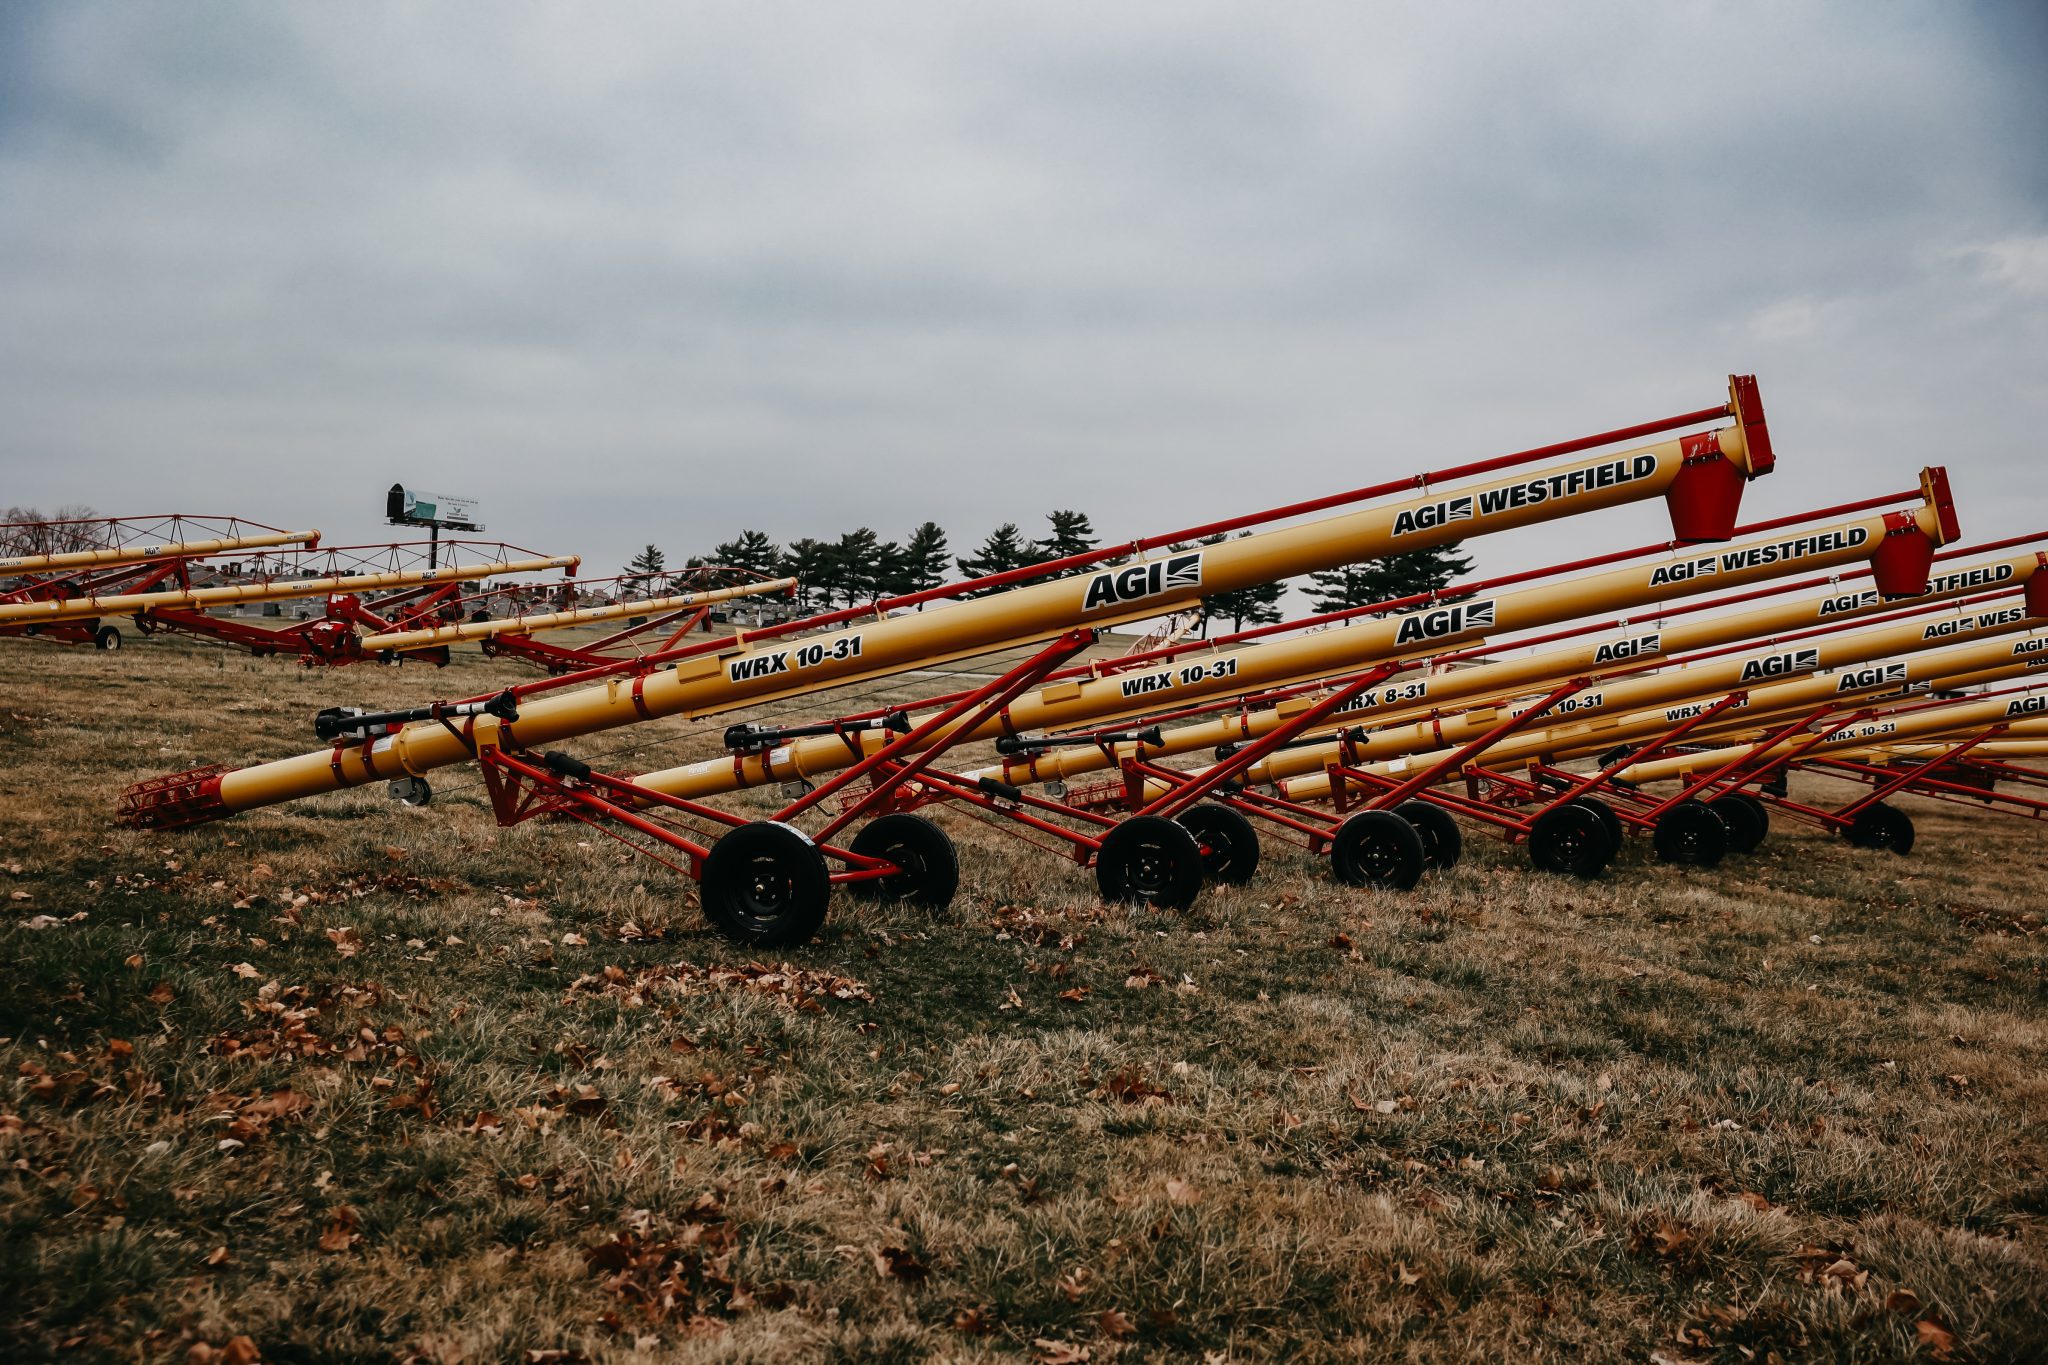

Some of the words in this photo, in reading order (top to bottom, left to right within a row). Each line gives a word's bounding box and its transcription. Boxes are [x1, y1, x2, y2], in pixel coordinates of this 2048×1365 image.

[1392, 502, 1446, 536] AGI
[1478, 454, 1657, 515] WESTFIELD
[1650, 560, 1695, 586] AGI
[1721, 527, 1868, 571] WESTFIELD
[1084, 562, 1163, 609] AGI
[1819, 593, 1859, 615] AGI
[1396, 606, 1462, 645] AGI
[1923, 618, 1958, 639] AGI
[730, 650, 789, 682] WRX
[795, 634, 863, 668] 10-31
[1595, 638, 1639, 663] AGI
[2013, 638, 2043, 655] AGI
[1121, 671, 1173, 698] WRX
[1179, 658, 1237, 685] 10-31
[1741, 653, 1793, 681] AGI
[1836, 667, 1884, 692] AGI
[1384, 682, 1427, 704] 8-31
[1558, 693, 1603, 714] 10-31
[2006, 695, 2046, 716] AGI
[1666, 704, 1702, 721] WRX
[1861, 722, 1896, 737] 10-31
